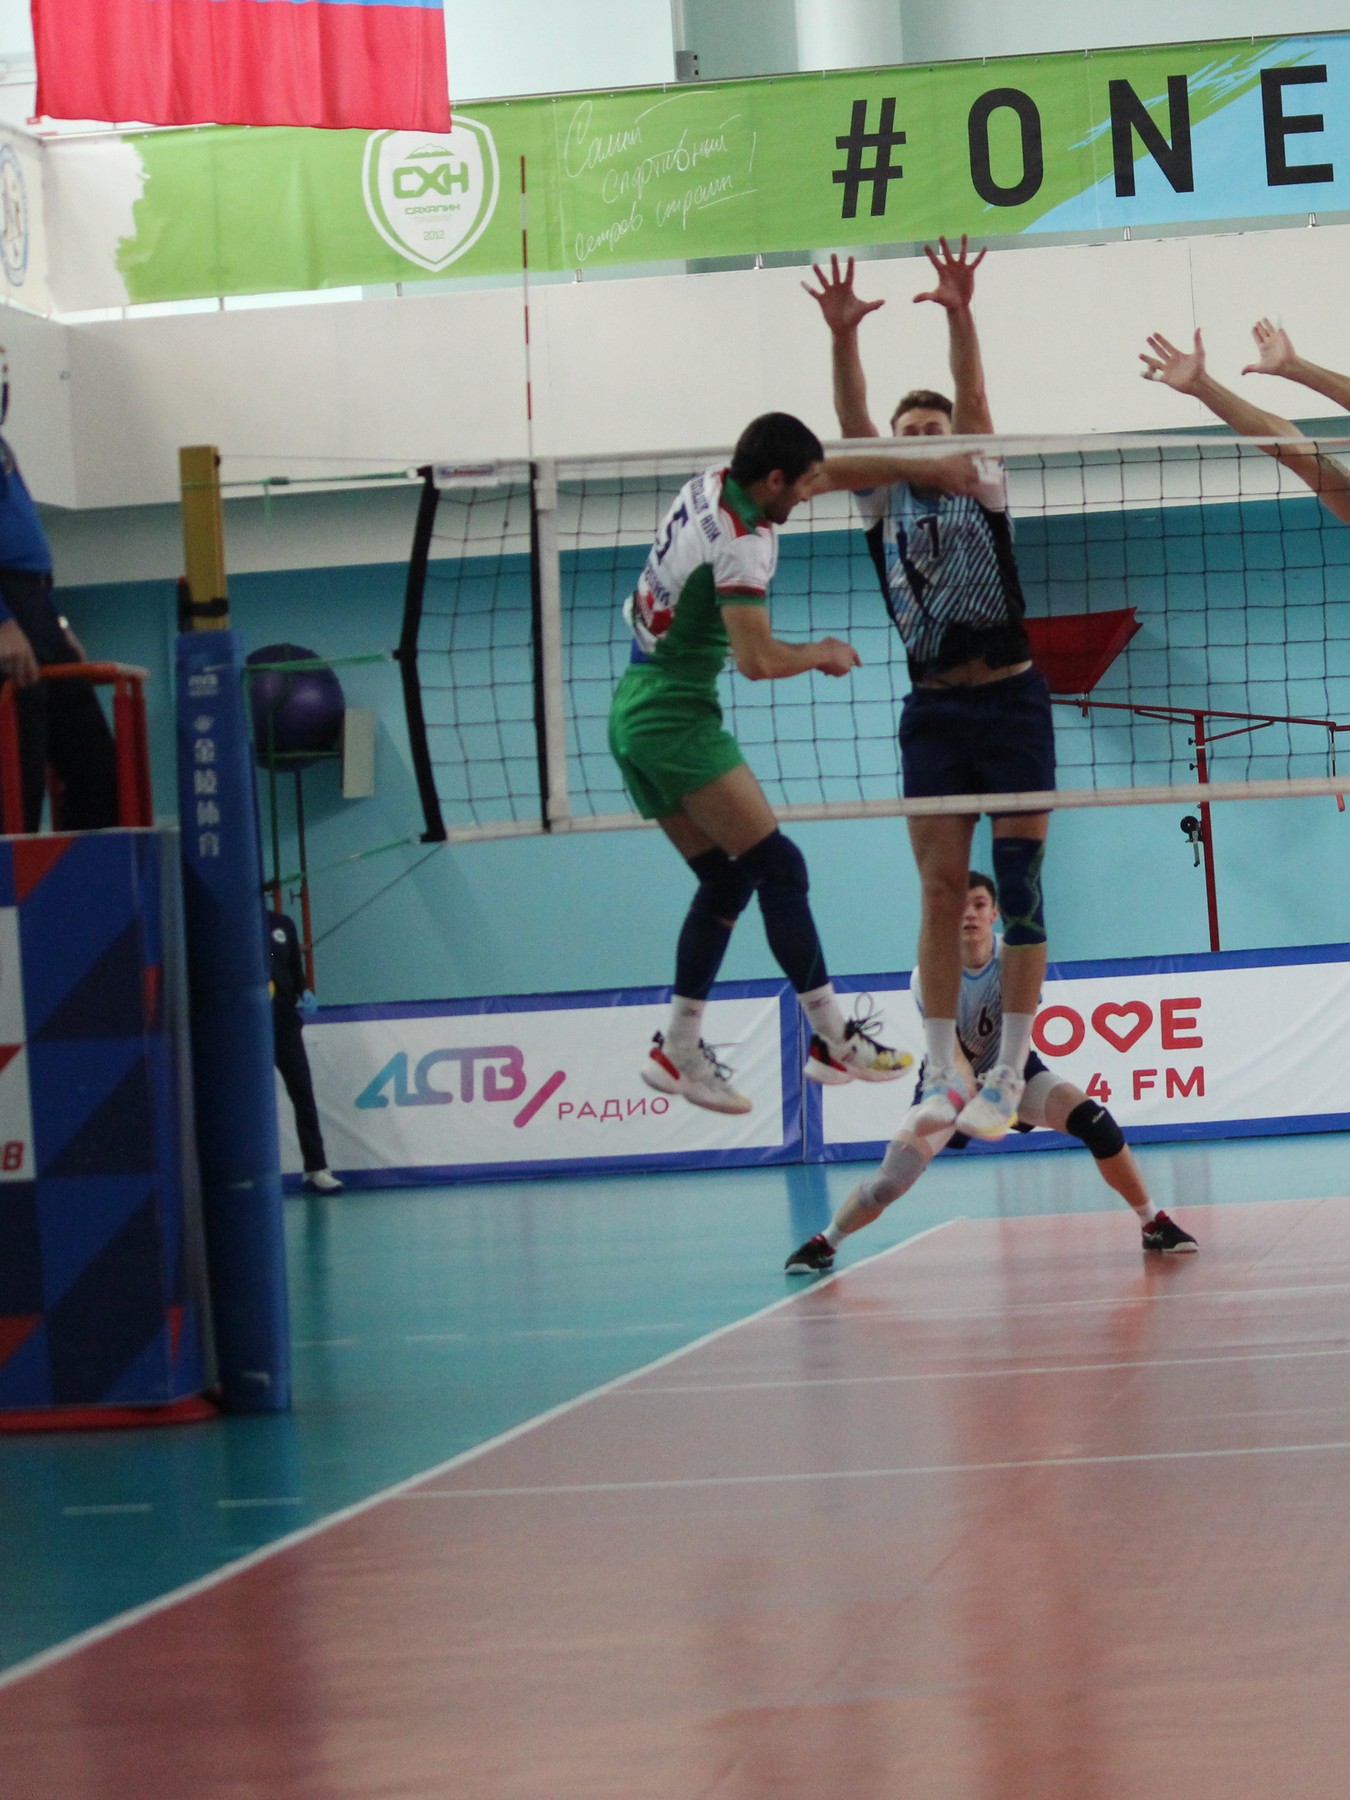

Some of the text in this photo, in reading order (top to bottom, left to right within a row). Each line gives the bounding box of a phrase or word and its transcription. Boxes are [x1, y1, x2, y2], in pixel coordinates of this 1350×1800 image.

[423, 230, 445, 241] 2012
[978, 1005, 993, 1037] 6
[1132, 1066, 1205, 1101] FM
[558, 1097, 670, 1122] РАДИО
